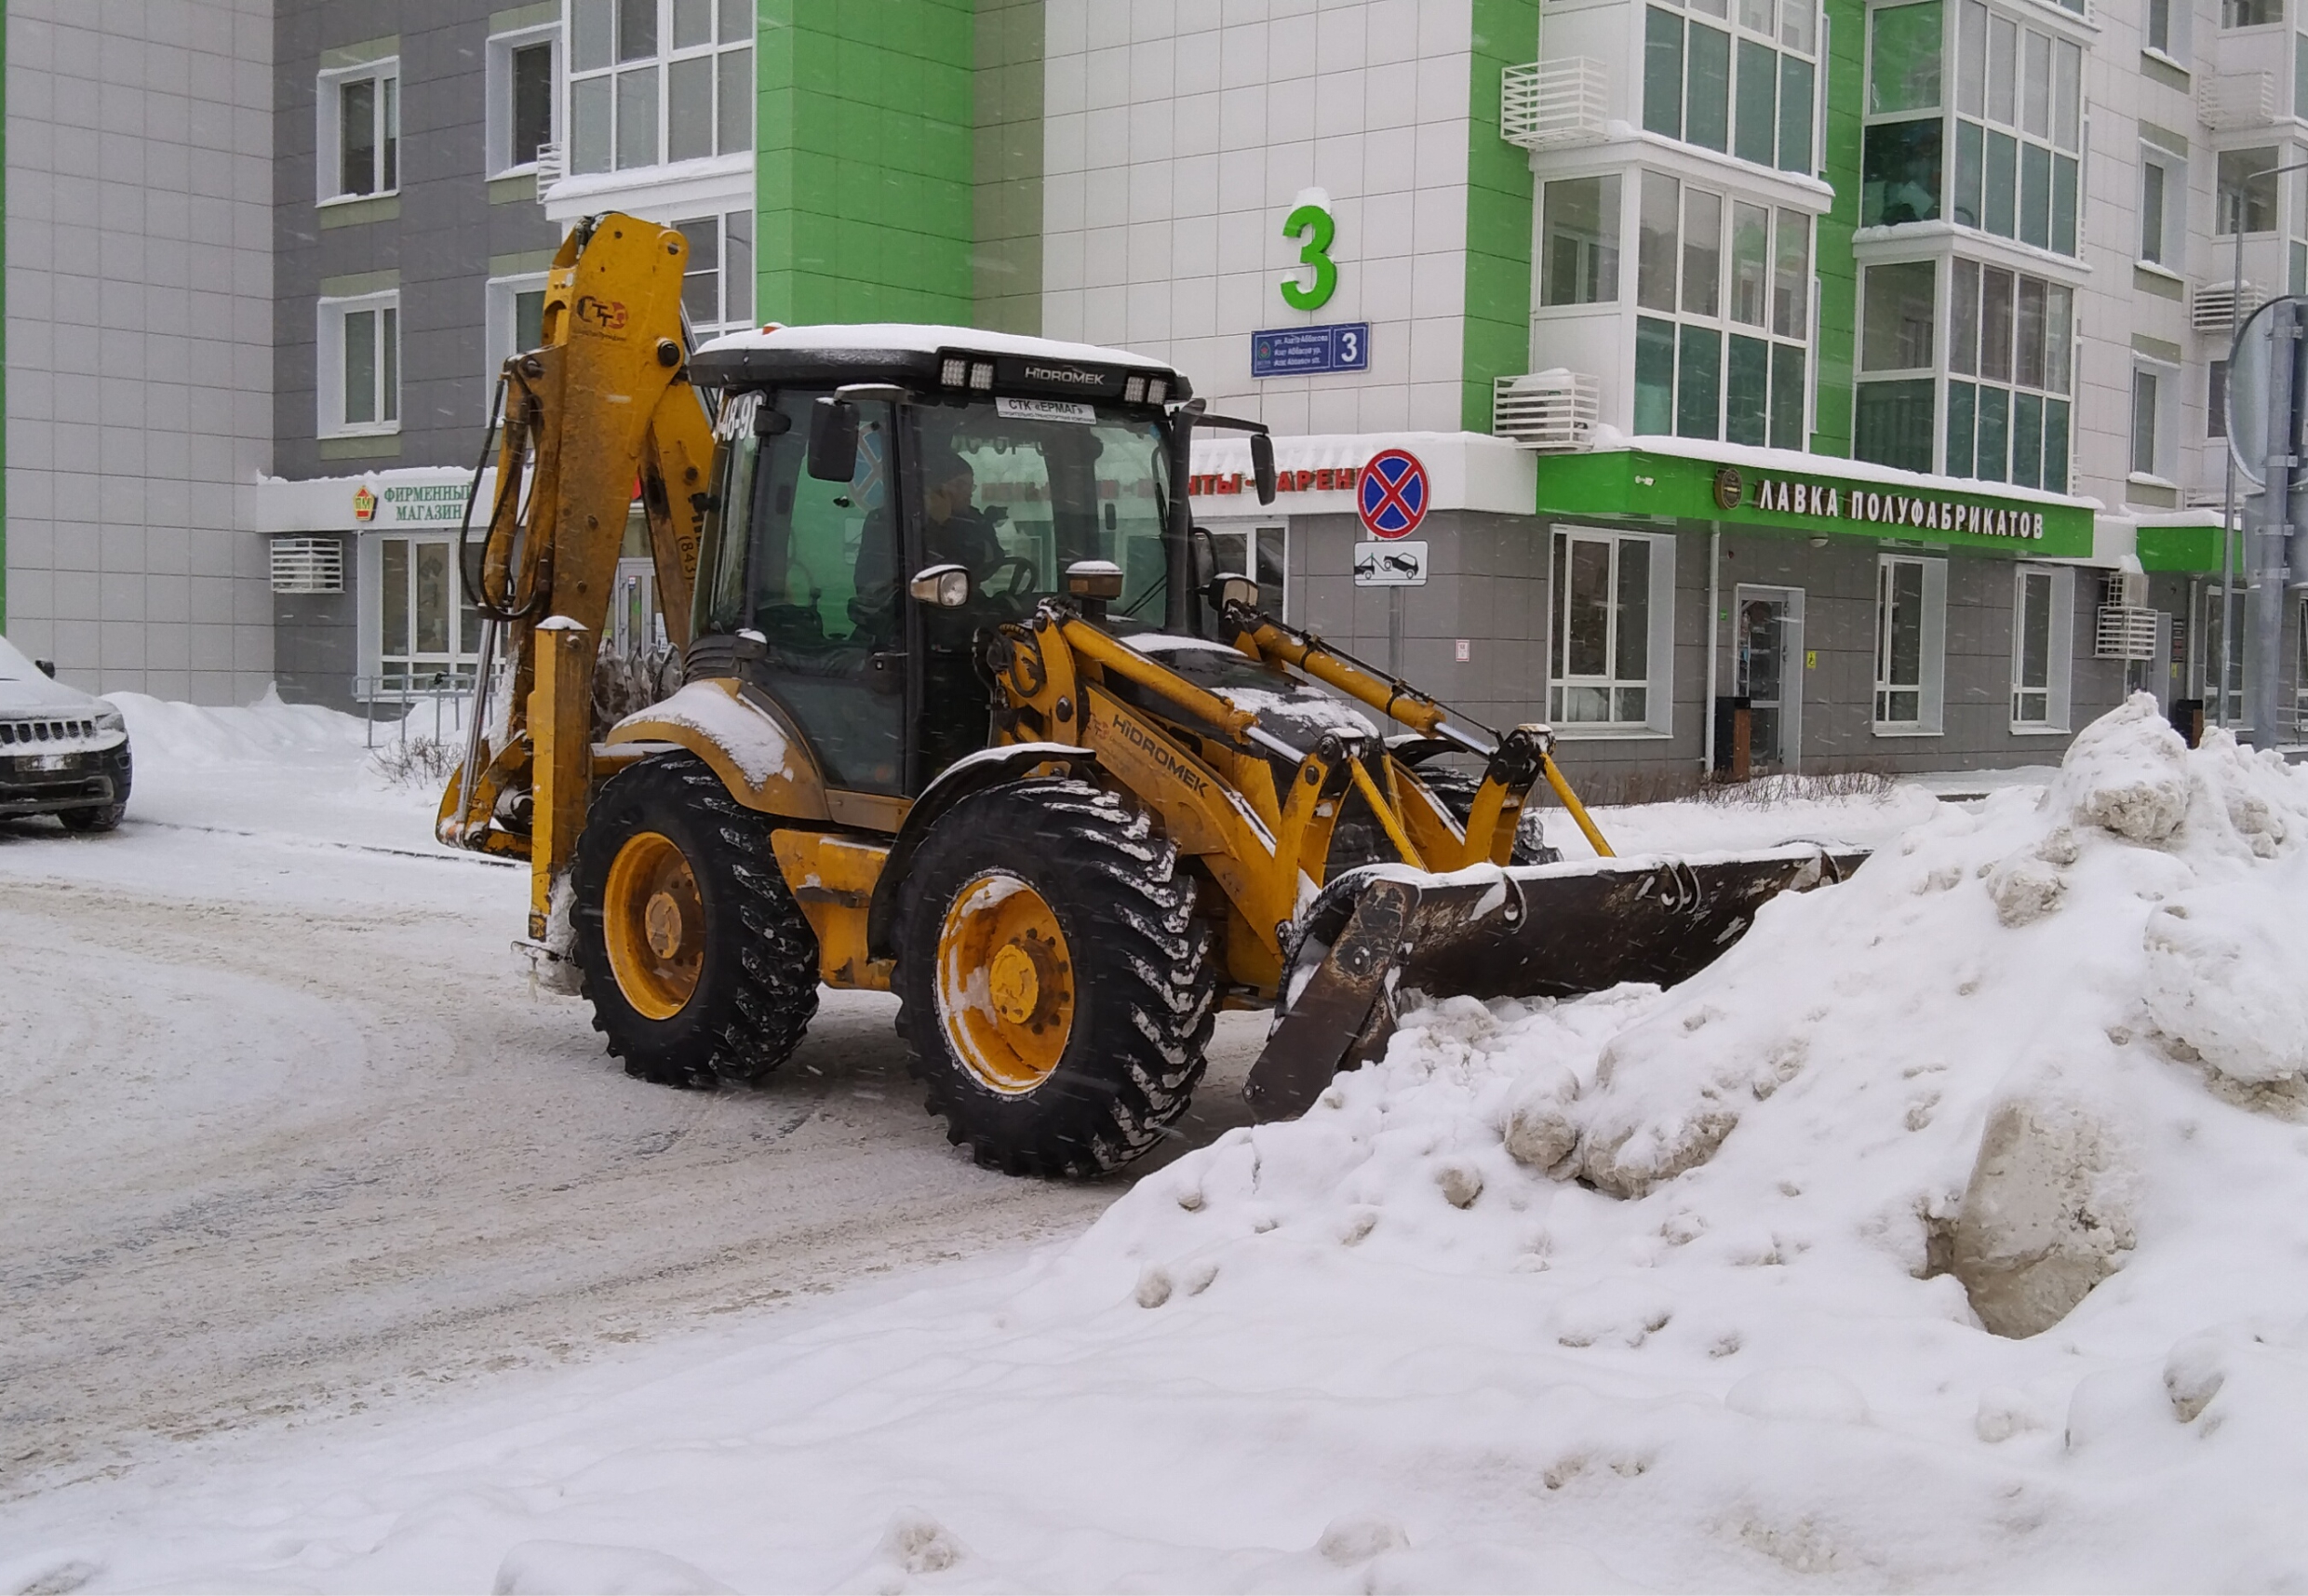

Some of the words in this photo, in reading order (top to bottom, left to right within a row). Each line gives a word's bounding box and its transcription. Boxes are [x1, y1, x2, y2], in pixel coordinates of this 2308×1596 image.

[1281, 206, 1337, 311] 3
[1341, 332, 1358, 362] 3
[1009, 398, 1031, 410] СТК
[1276, 467, 1363, 492] АРЕН
[396, 504, 463, 521] МАГАЗИН
[1759, 479, 1839, 517] ЛАВКА
[1850, 490, 2044, 540] ПОЛУФАБРИКАТОВ
